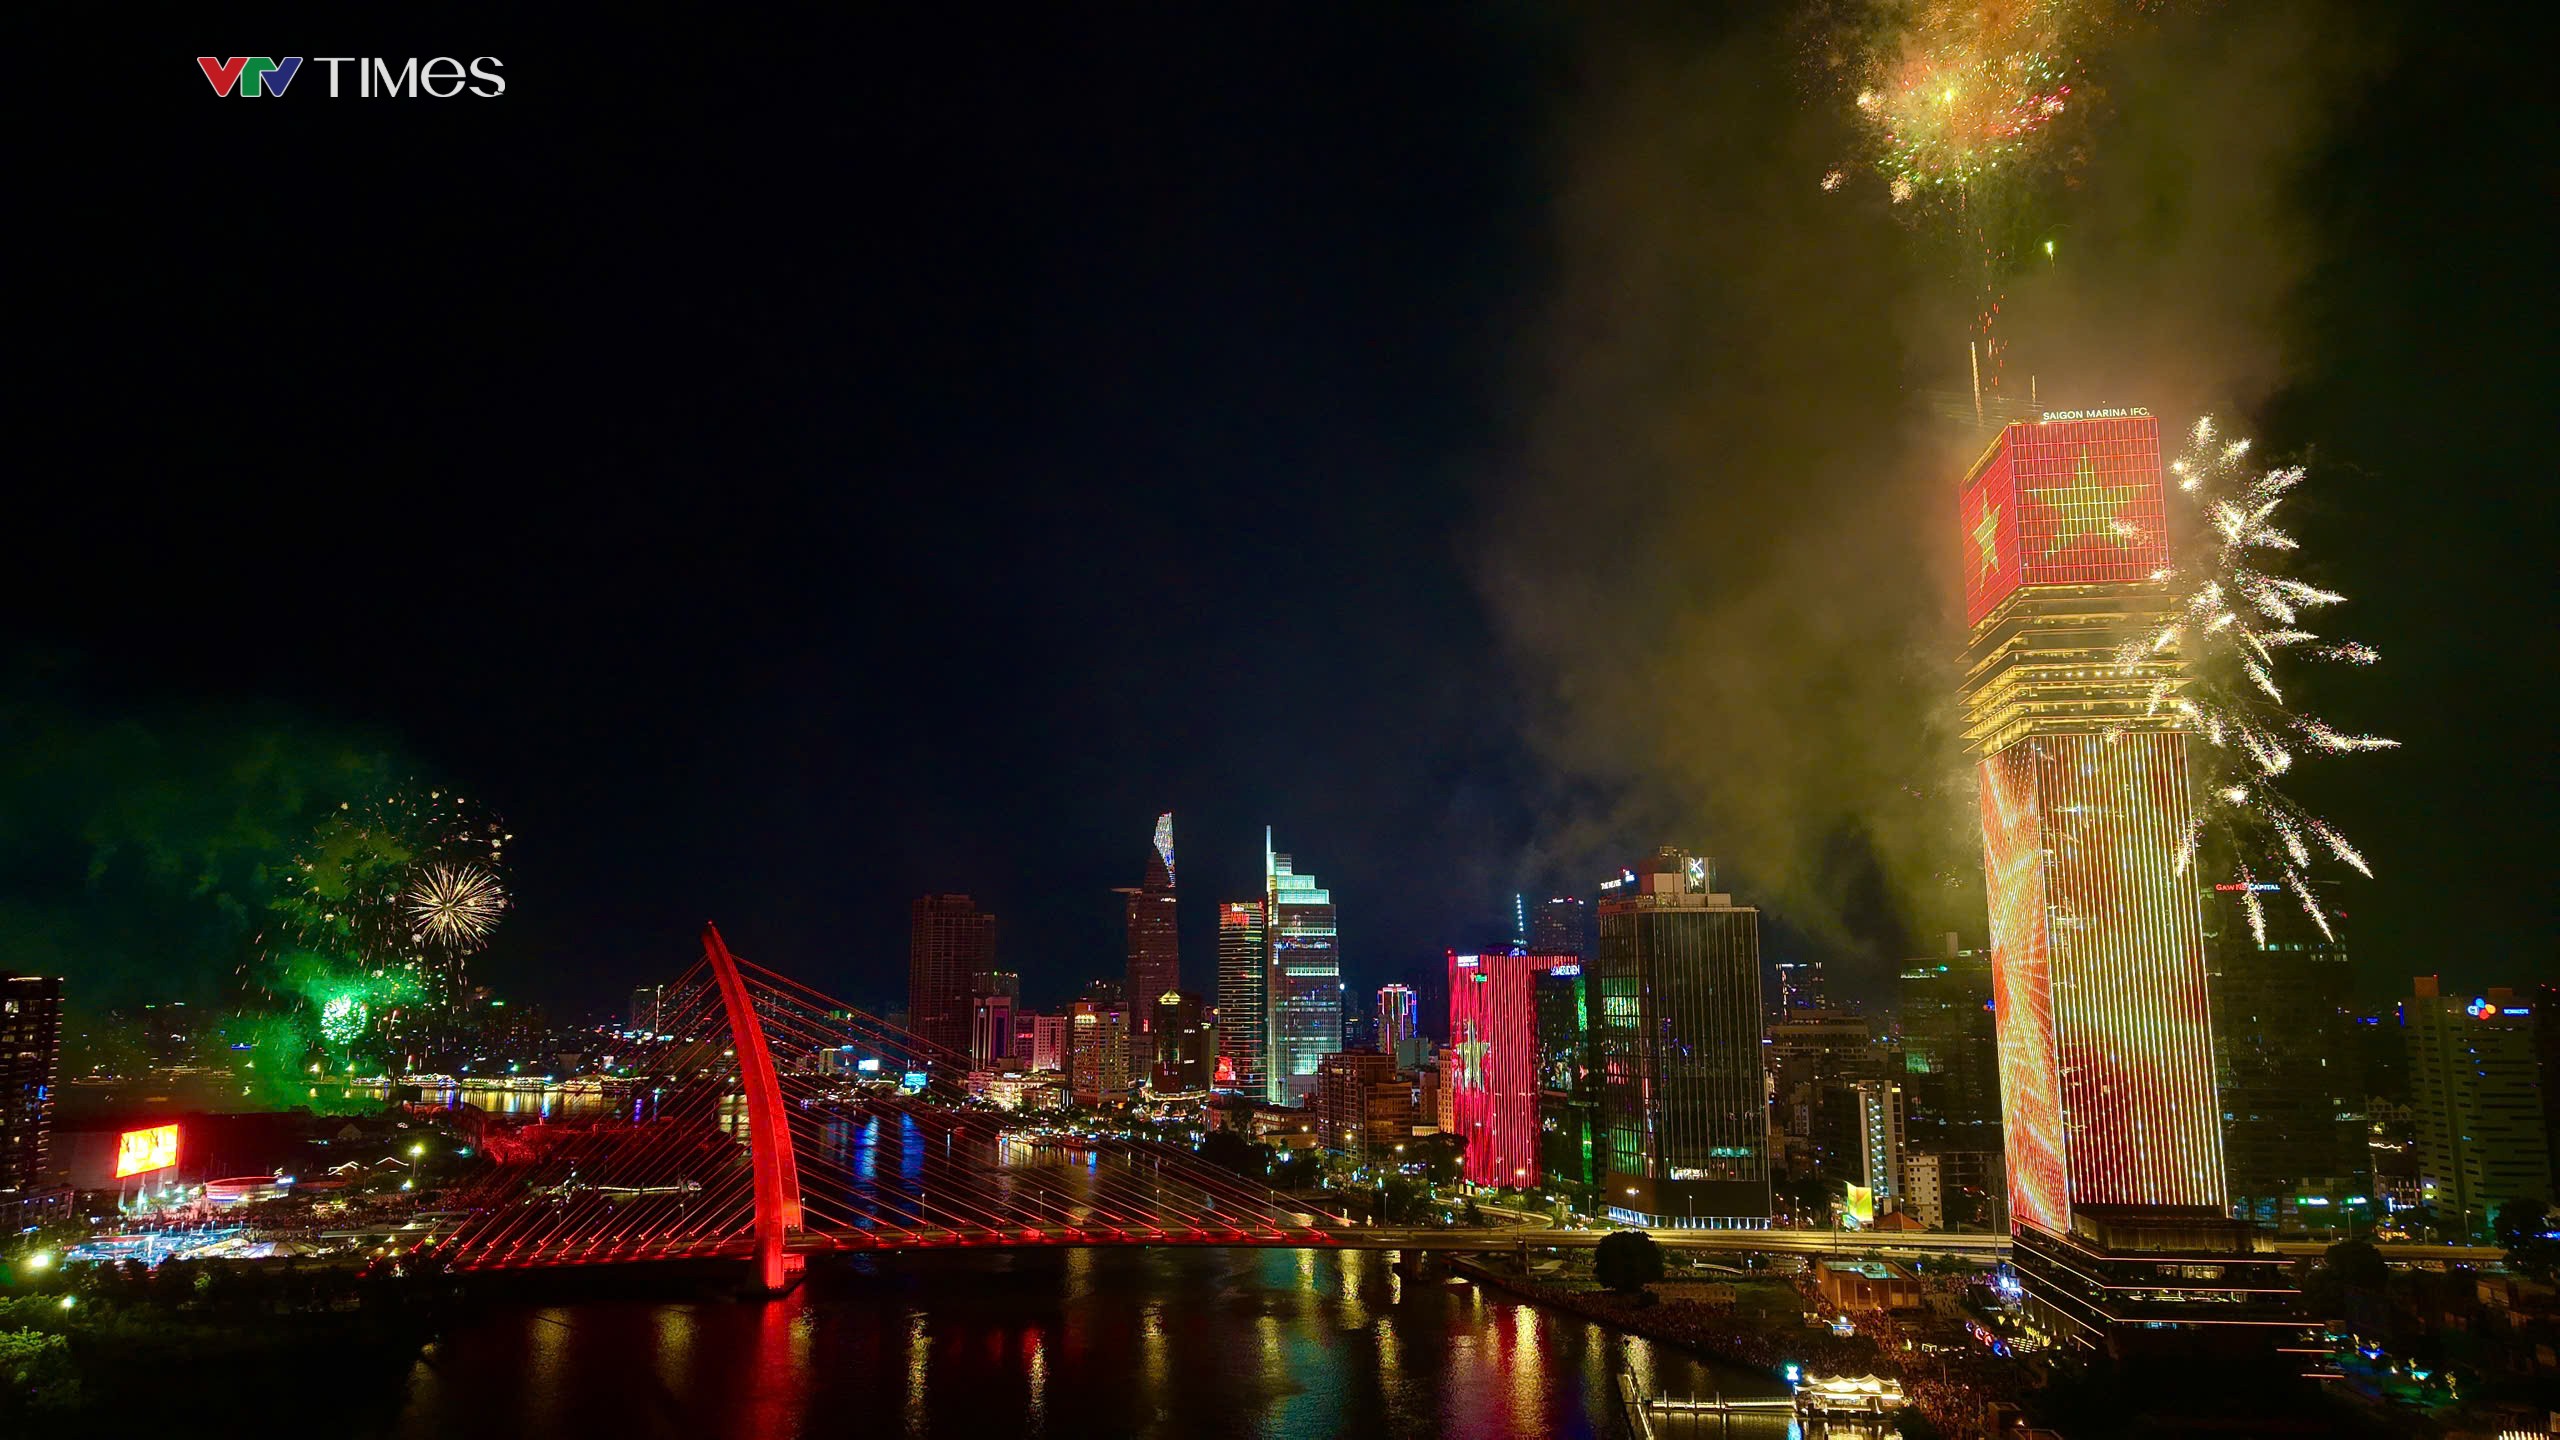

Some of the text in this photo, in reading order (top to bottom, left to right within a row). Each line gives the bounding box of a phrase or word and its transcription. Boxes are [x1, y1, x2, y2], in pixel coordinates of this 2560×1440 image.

[2043, 410, 2083, 420] SAIGON
[2086, 408, 2128, 419] MARINA
[2215, 883, 2235, 891] GAW
[2248, 883, 2280, 891] CAPITAL
